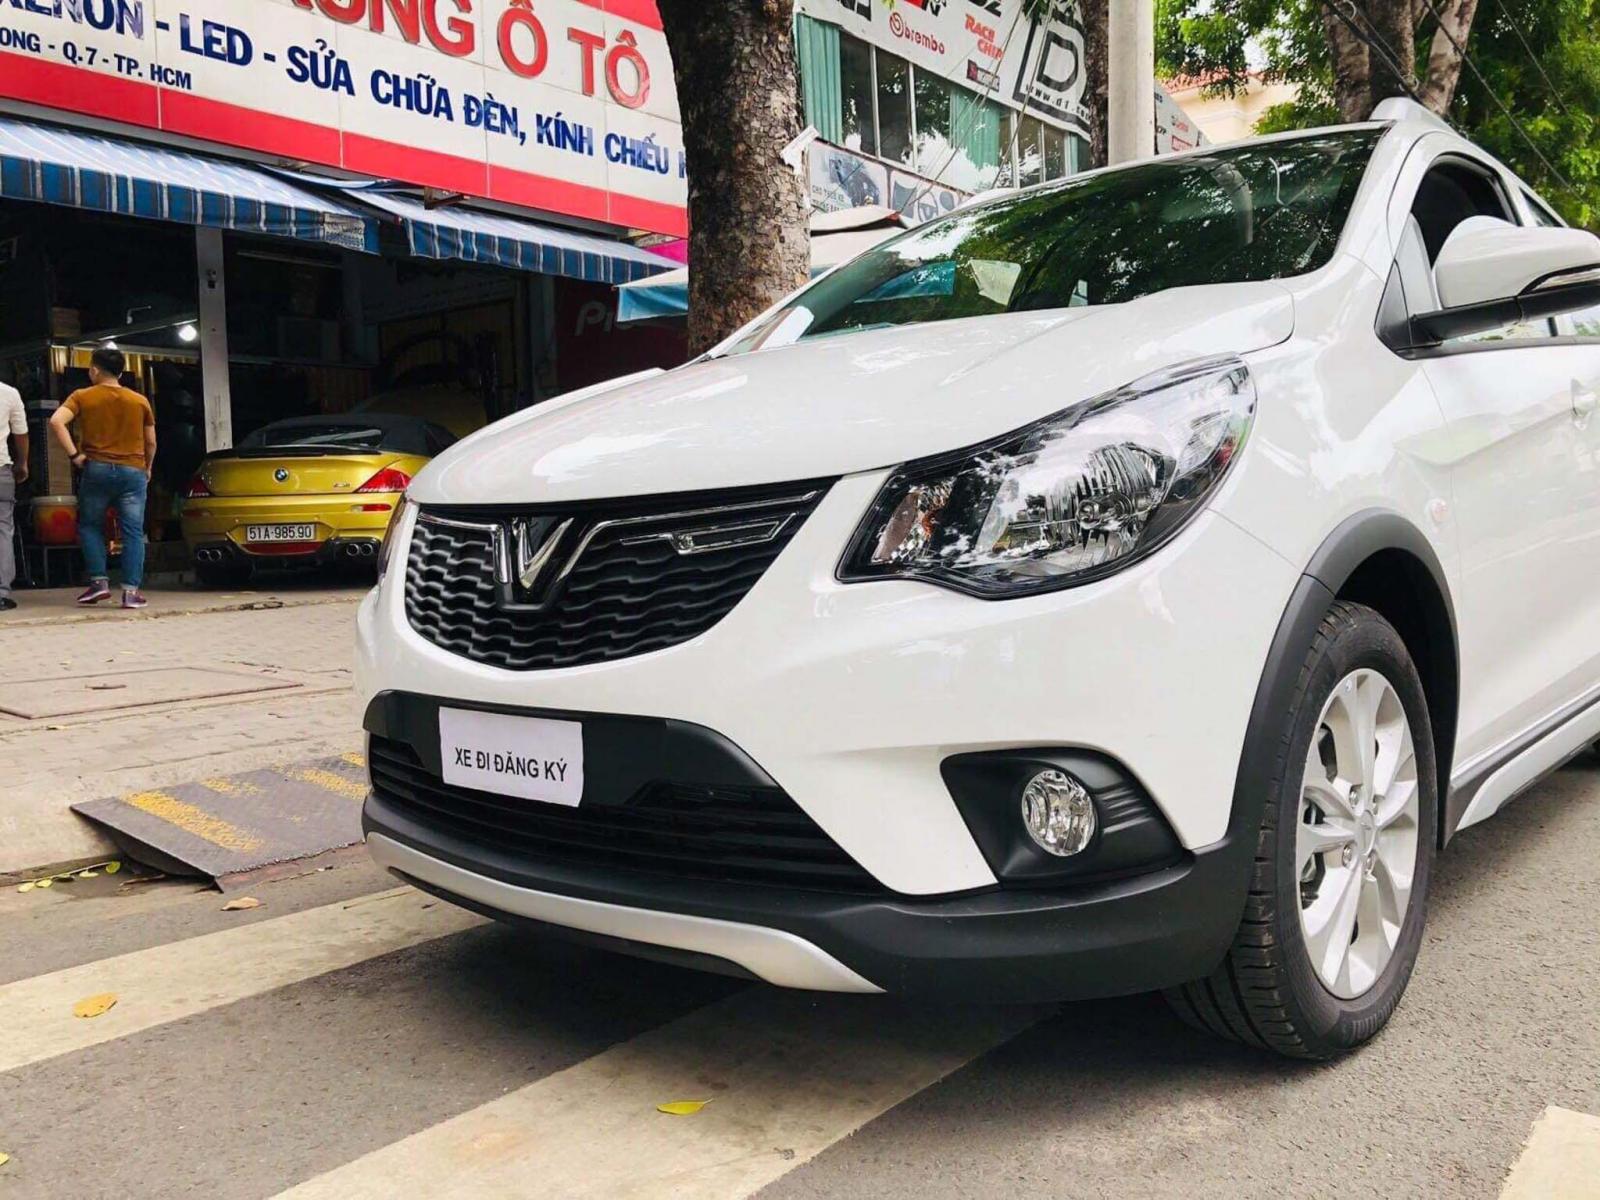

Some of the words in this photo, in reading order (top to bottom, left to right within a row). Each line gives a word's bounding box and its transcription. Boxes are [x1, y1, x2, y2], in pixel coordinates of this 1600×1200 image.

[63, 41, 97, 65] Q.7
[114, 53, 143, 77] TP.
[150, 63, 192, 90] HCM
[178, 13, 253, 66] LED
[286, 38, 356, 96] SỬA
[370, 69, 454, 121] CHỮA
[463, 92, 526, 146] ĐÈN,
[536, 112, 594, 156] KÍNH
[604, 133, 669, 175] CHIẾU
[497, 0, 548, 79] Ô
[567, 29, 650, 109] TÔ
[455, 747, 472, 768] XE
[476, 751, 490, 770] ĐI
[494, 751, 539, 778] ĐĂNG
[544, 757, 567, 782] KÝ
